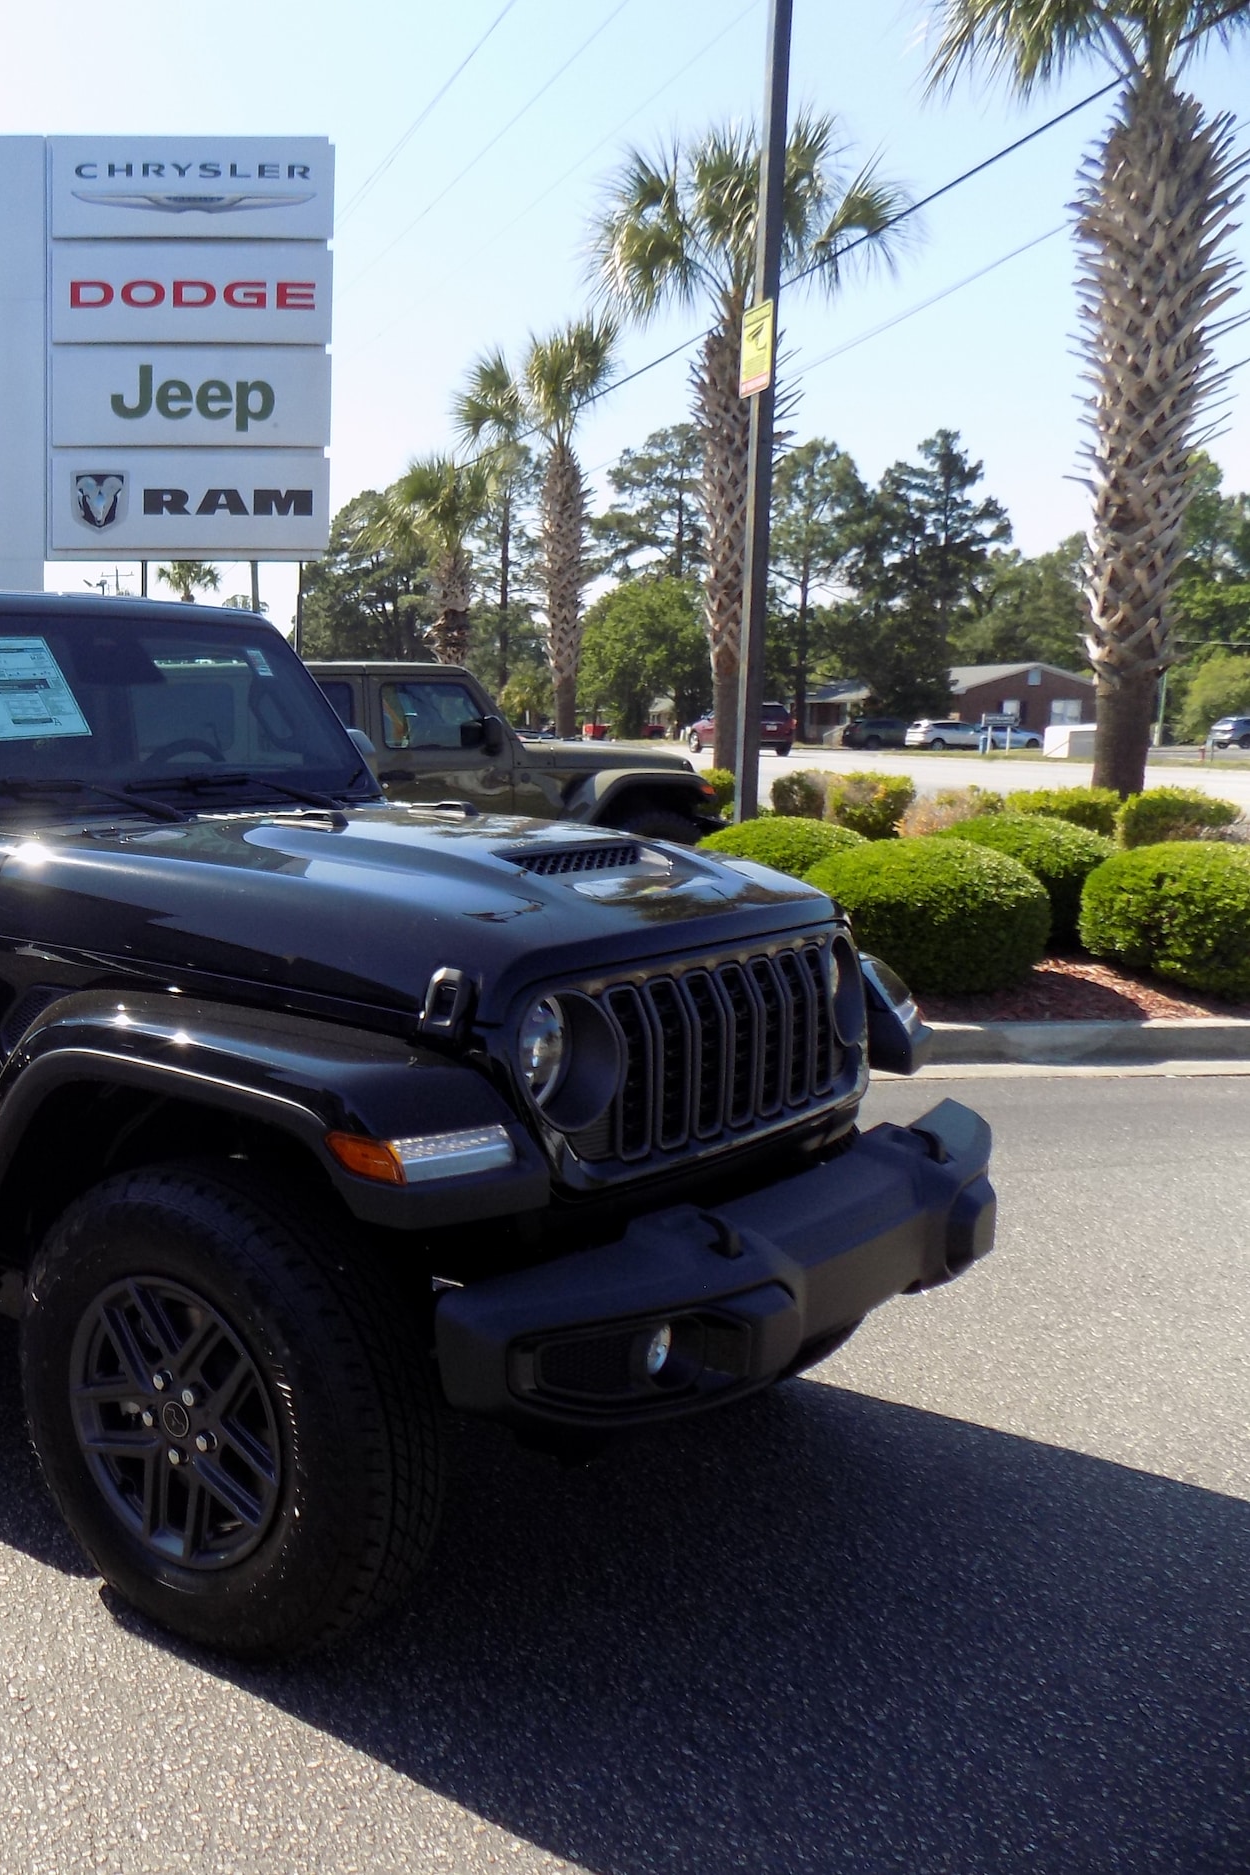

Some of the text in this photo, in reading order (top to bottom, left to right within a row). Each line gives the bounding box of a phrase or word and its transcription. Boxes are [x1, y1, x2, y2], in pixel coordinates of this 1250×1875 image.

[74, 163, 312, 180] CHRYSLER
[69, 280, 316, 310] DODGE
[110, 364, 275, 432] Jeep
[143, 488, 313, 516] RAM
